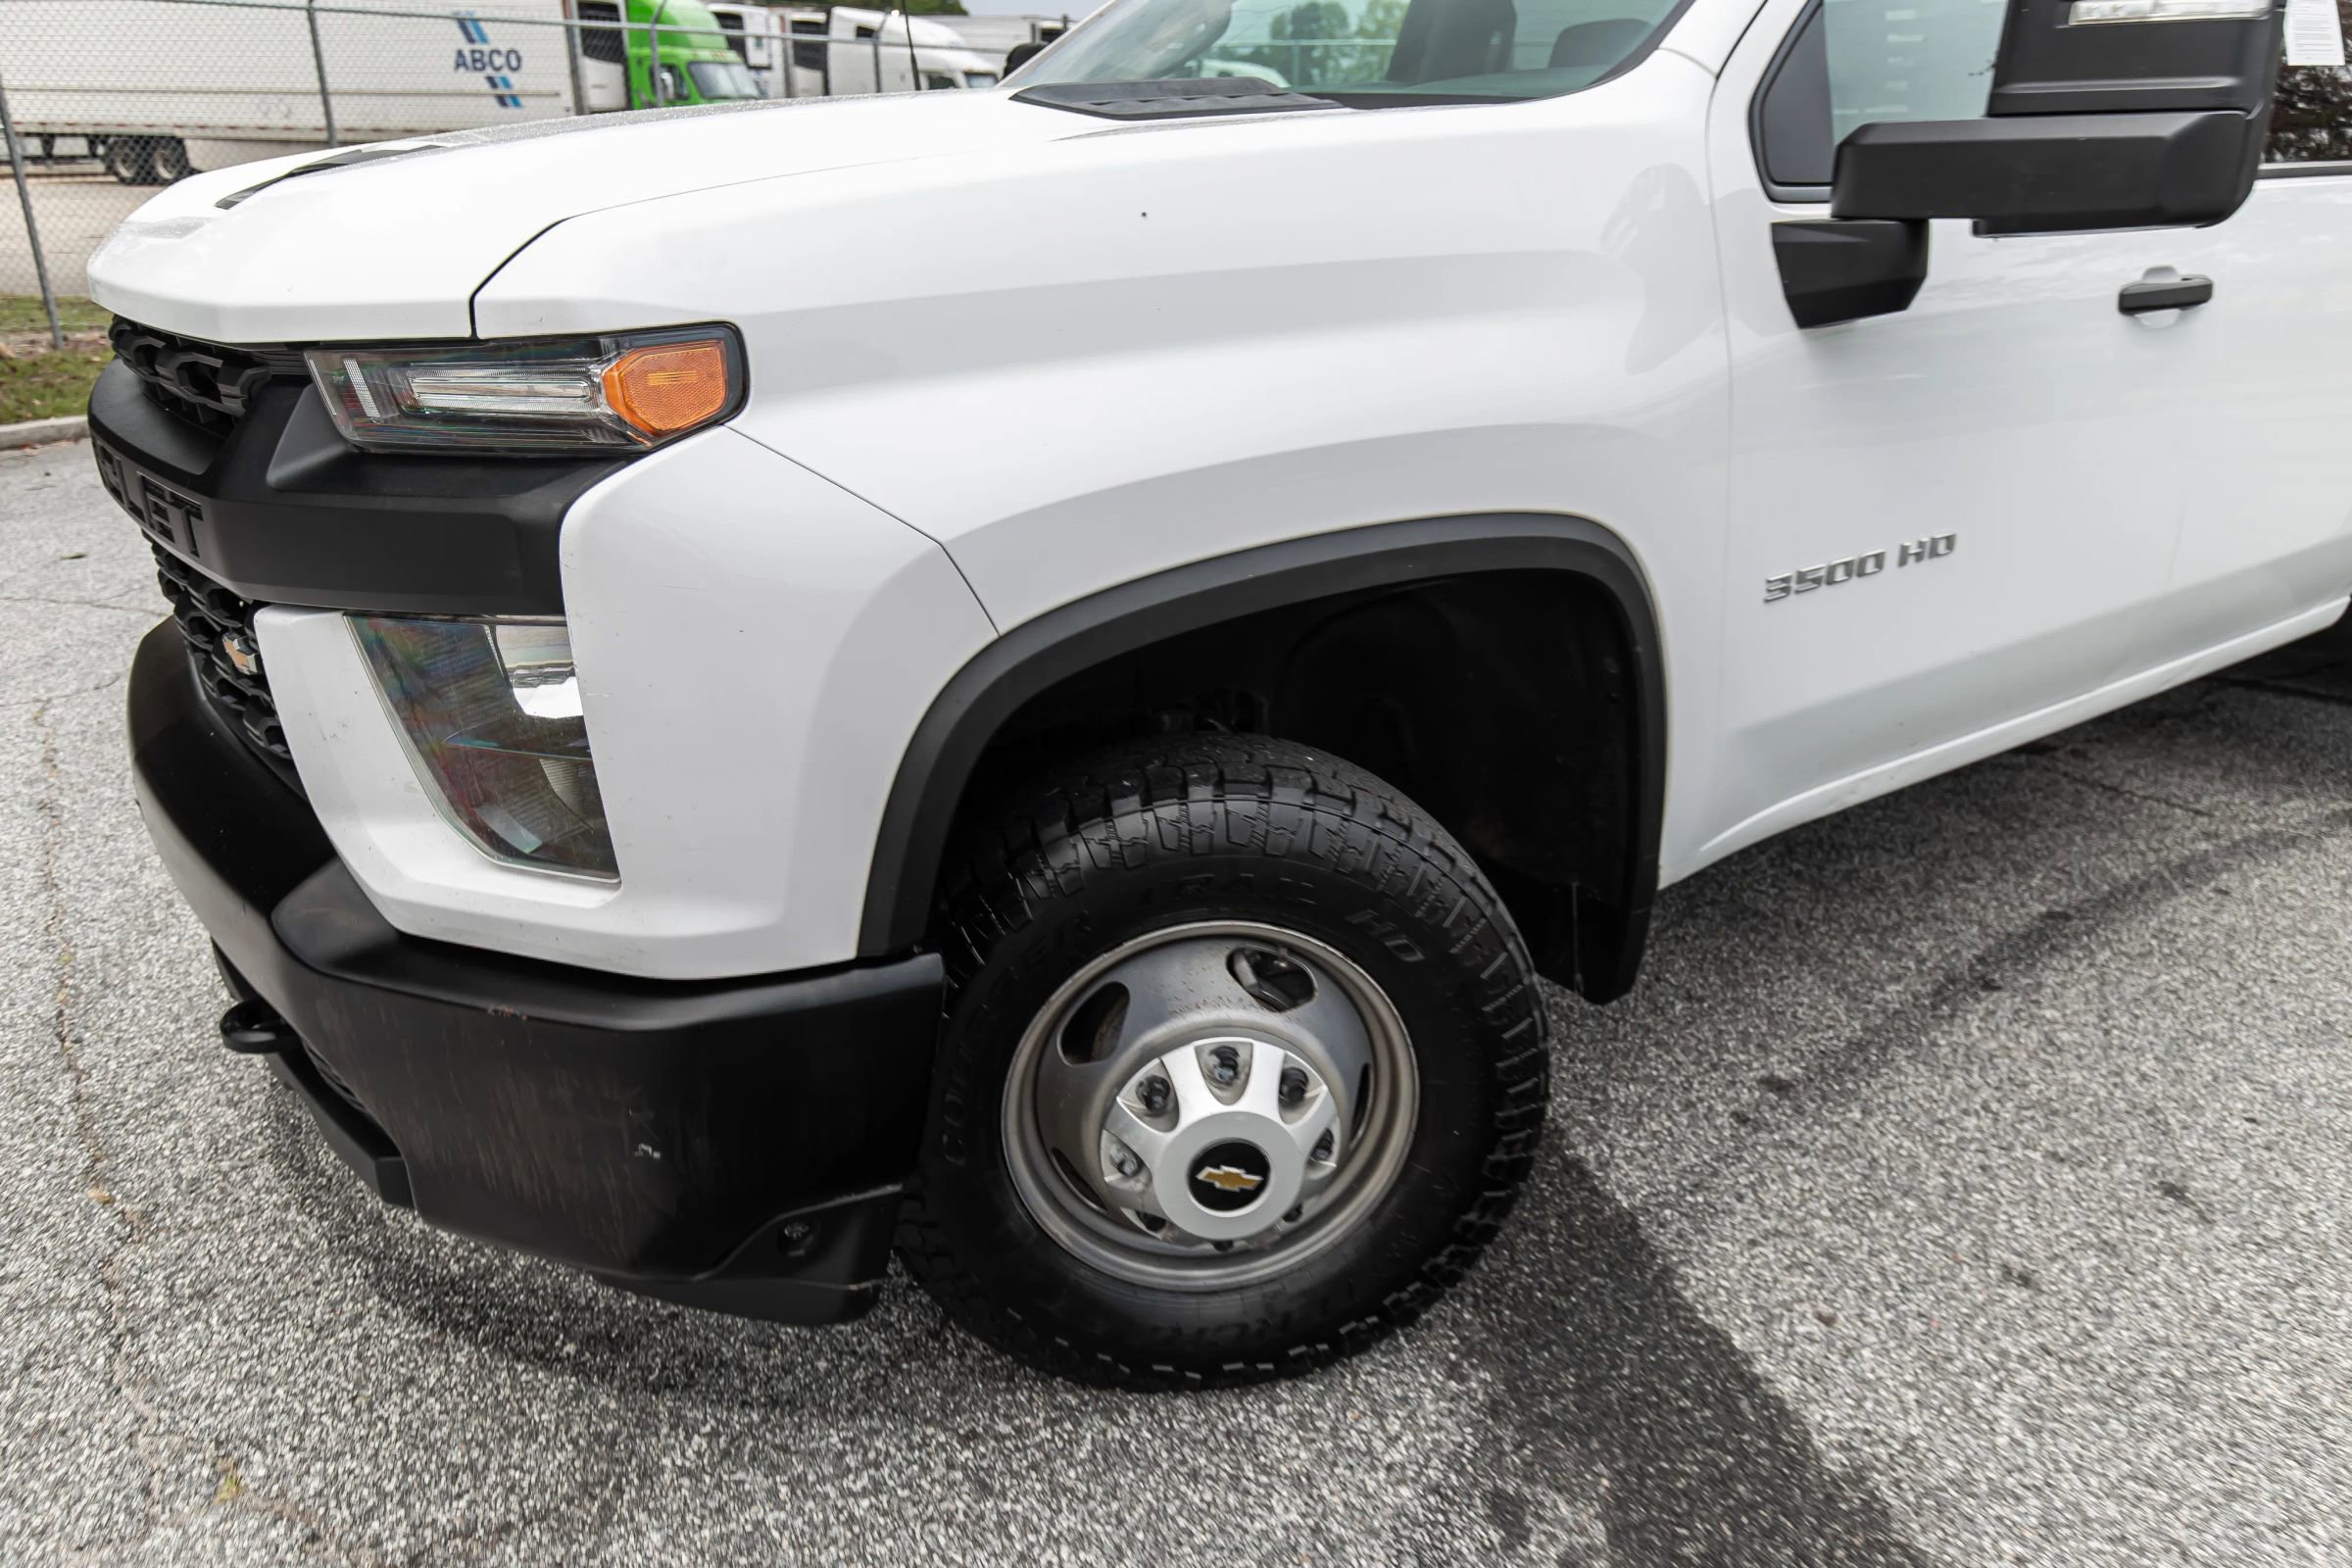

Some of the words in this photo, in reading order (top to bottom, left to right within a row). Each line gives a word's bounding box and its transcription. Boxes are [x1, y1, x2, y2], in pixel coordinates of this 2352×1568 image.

[454, 48, 522, 73] ABCO
[1763, 549, 1886, 604] 3500
[1897, 532, 1958, 568] HD
